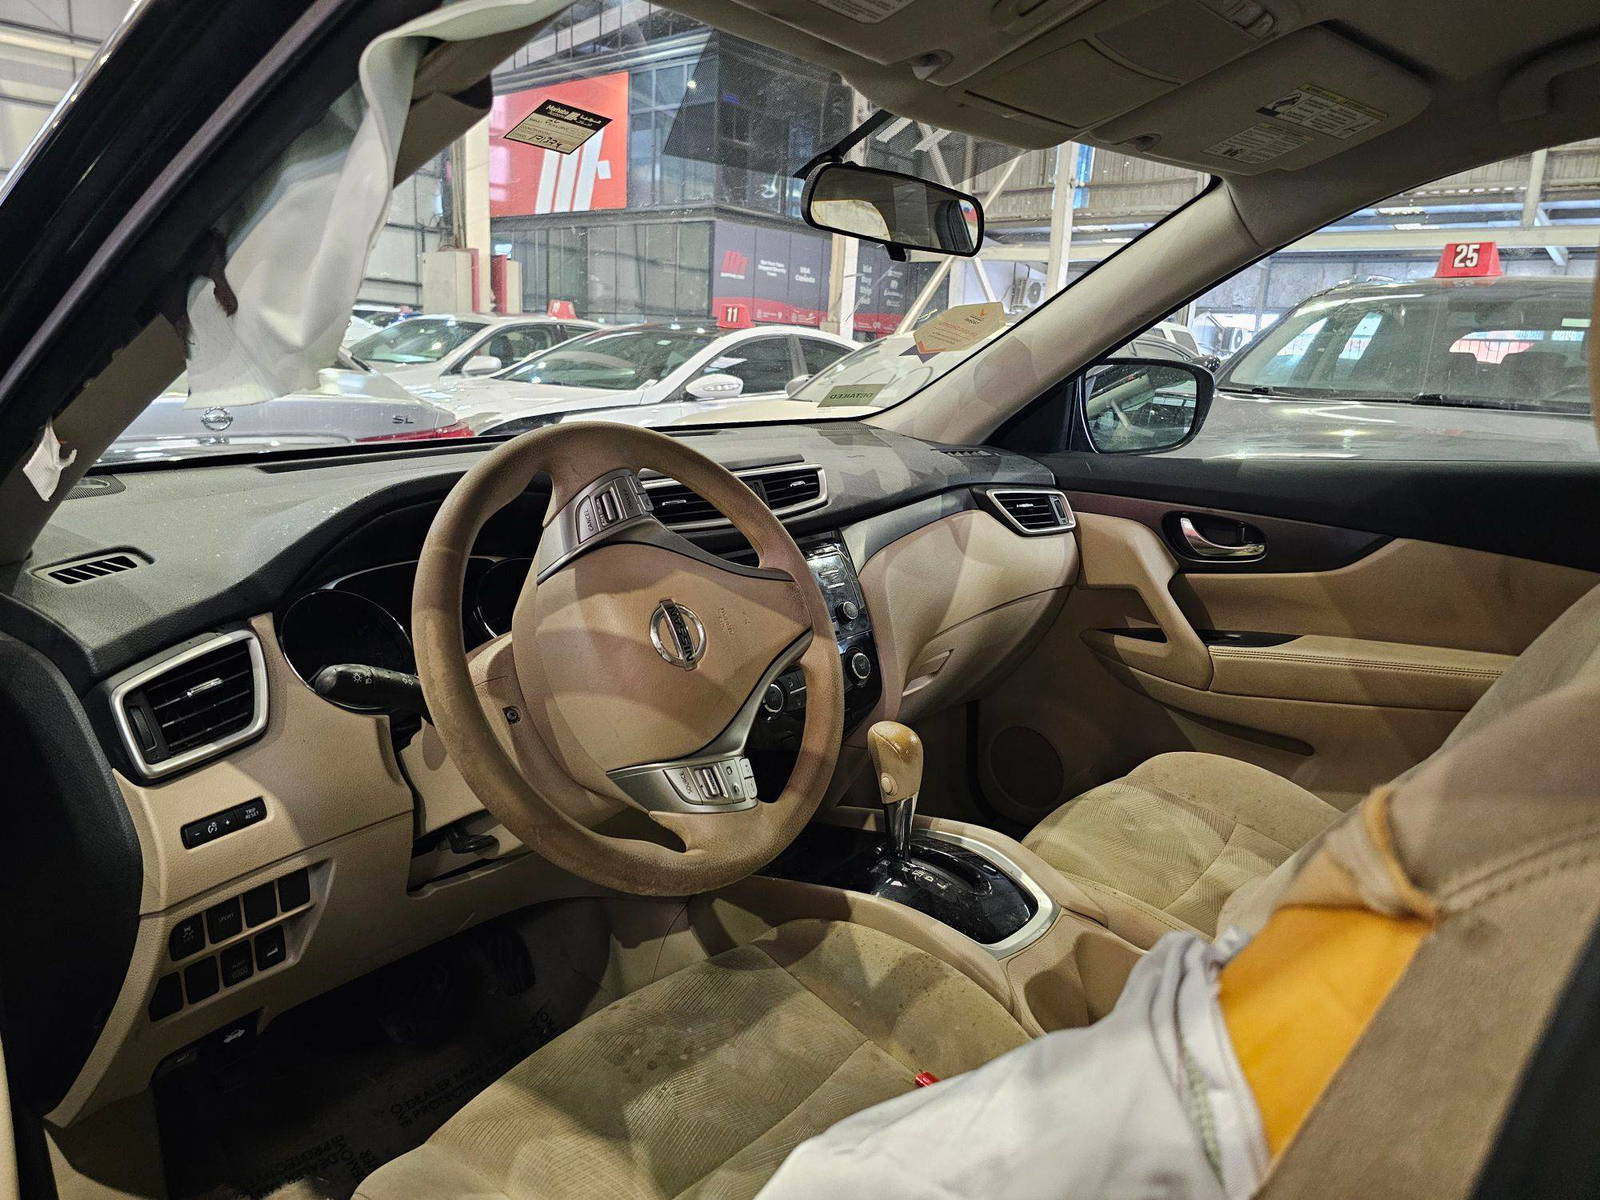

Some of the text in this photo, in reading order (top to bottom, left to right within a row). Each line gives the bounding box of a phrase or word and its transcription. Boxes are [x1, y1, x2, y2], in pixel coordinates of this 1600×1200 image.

[1453, 243, 1481, 269] 25
[727, 306, 739, 323] 11
[391, 415, 415, 425] SL
[668, 605, 696, 663] NISSAN
